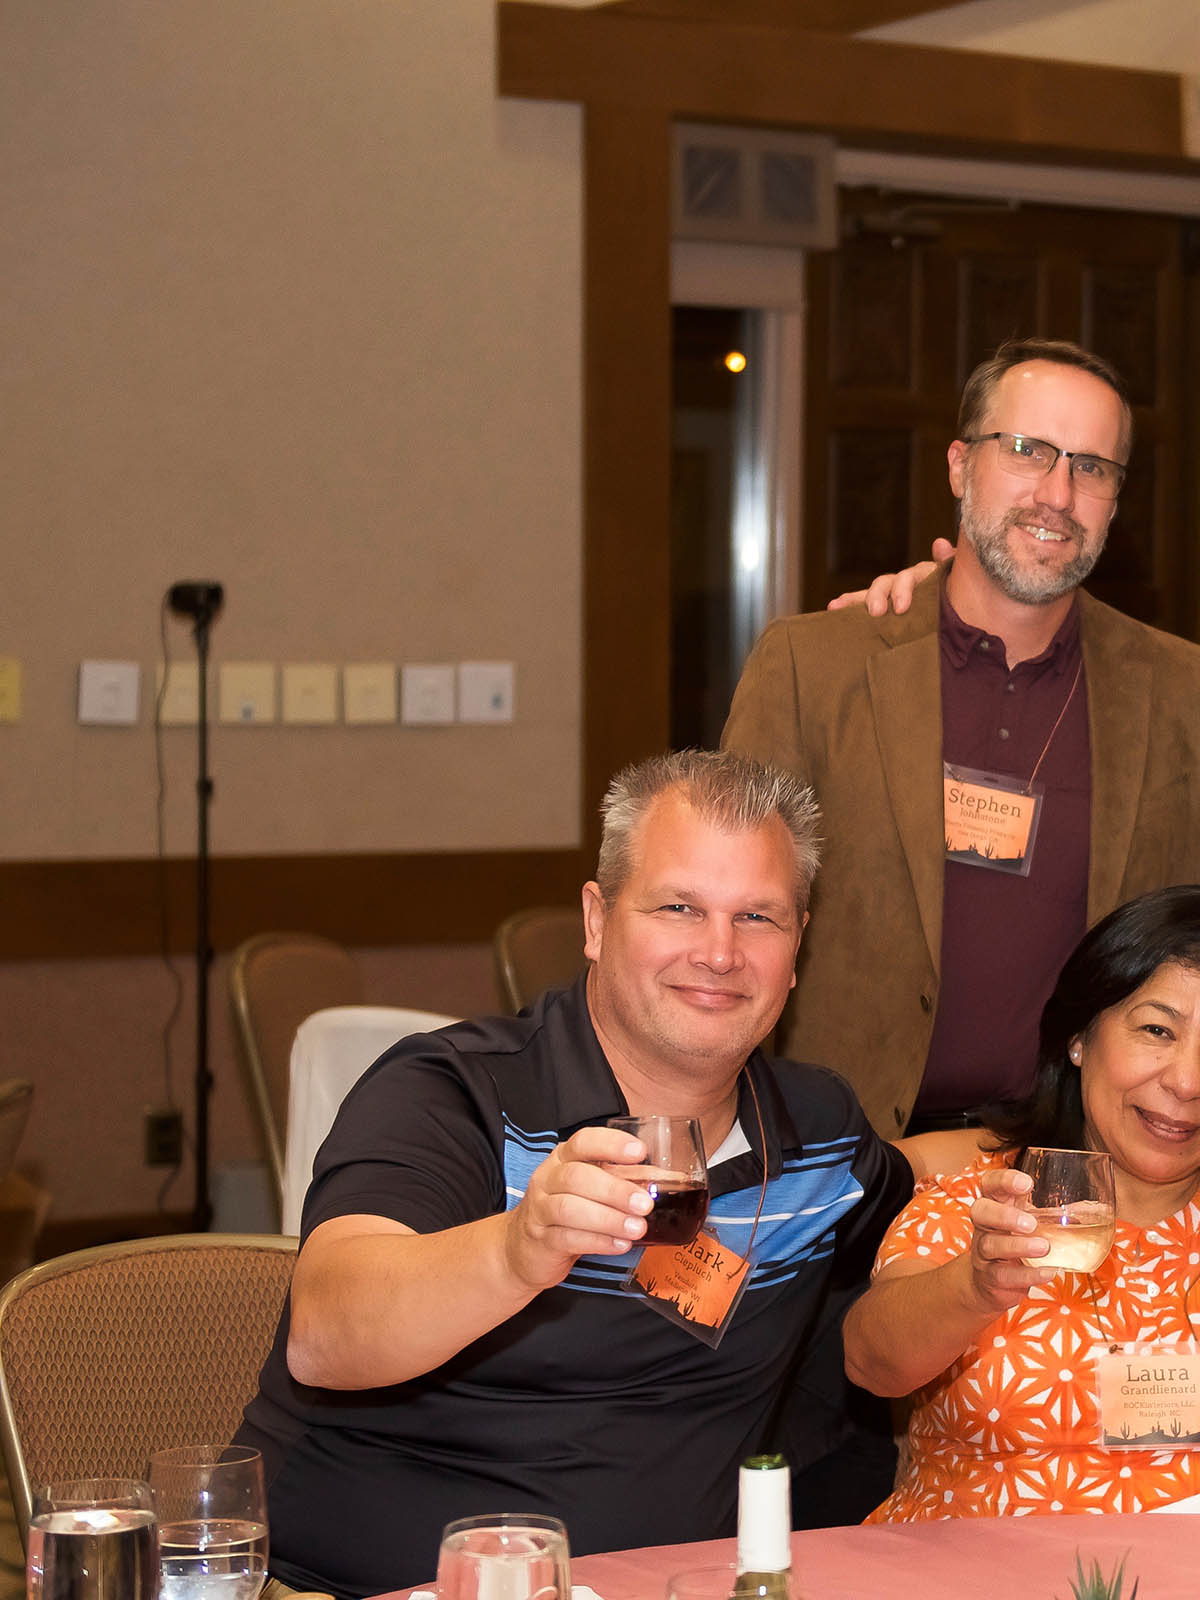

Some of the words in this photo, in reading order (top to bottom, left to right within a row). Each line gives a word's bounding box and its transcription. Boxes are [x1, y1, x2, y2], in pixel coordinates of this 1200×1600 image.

[948, 787, 1022, 819] Stephen
[1126, 1364, 1190, 1382] Laura
[1120, 1383, 1197, 1395] Grandlienard
